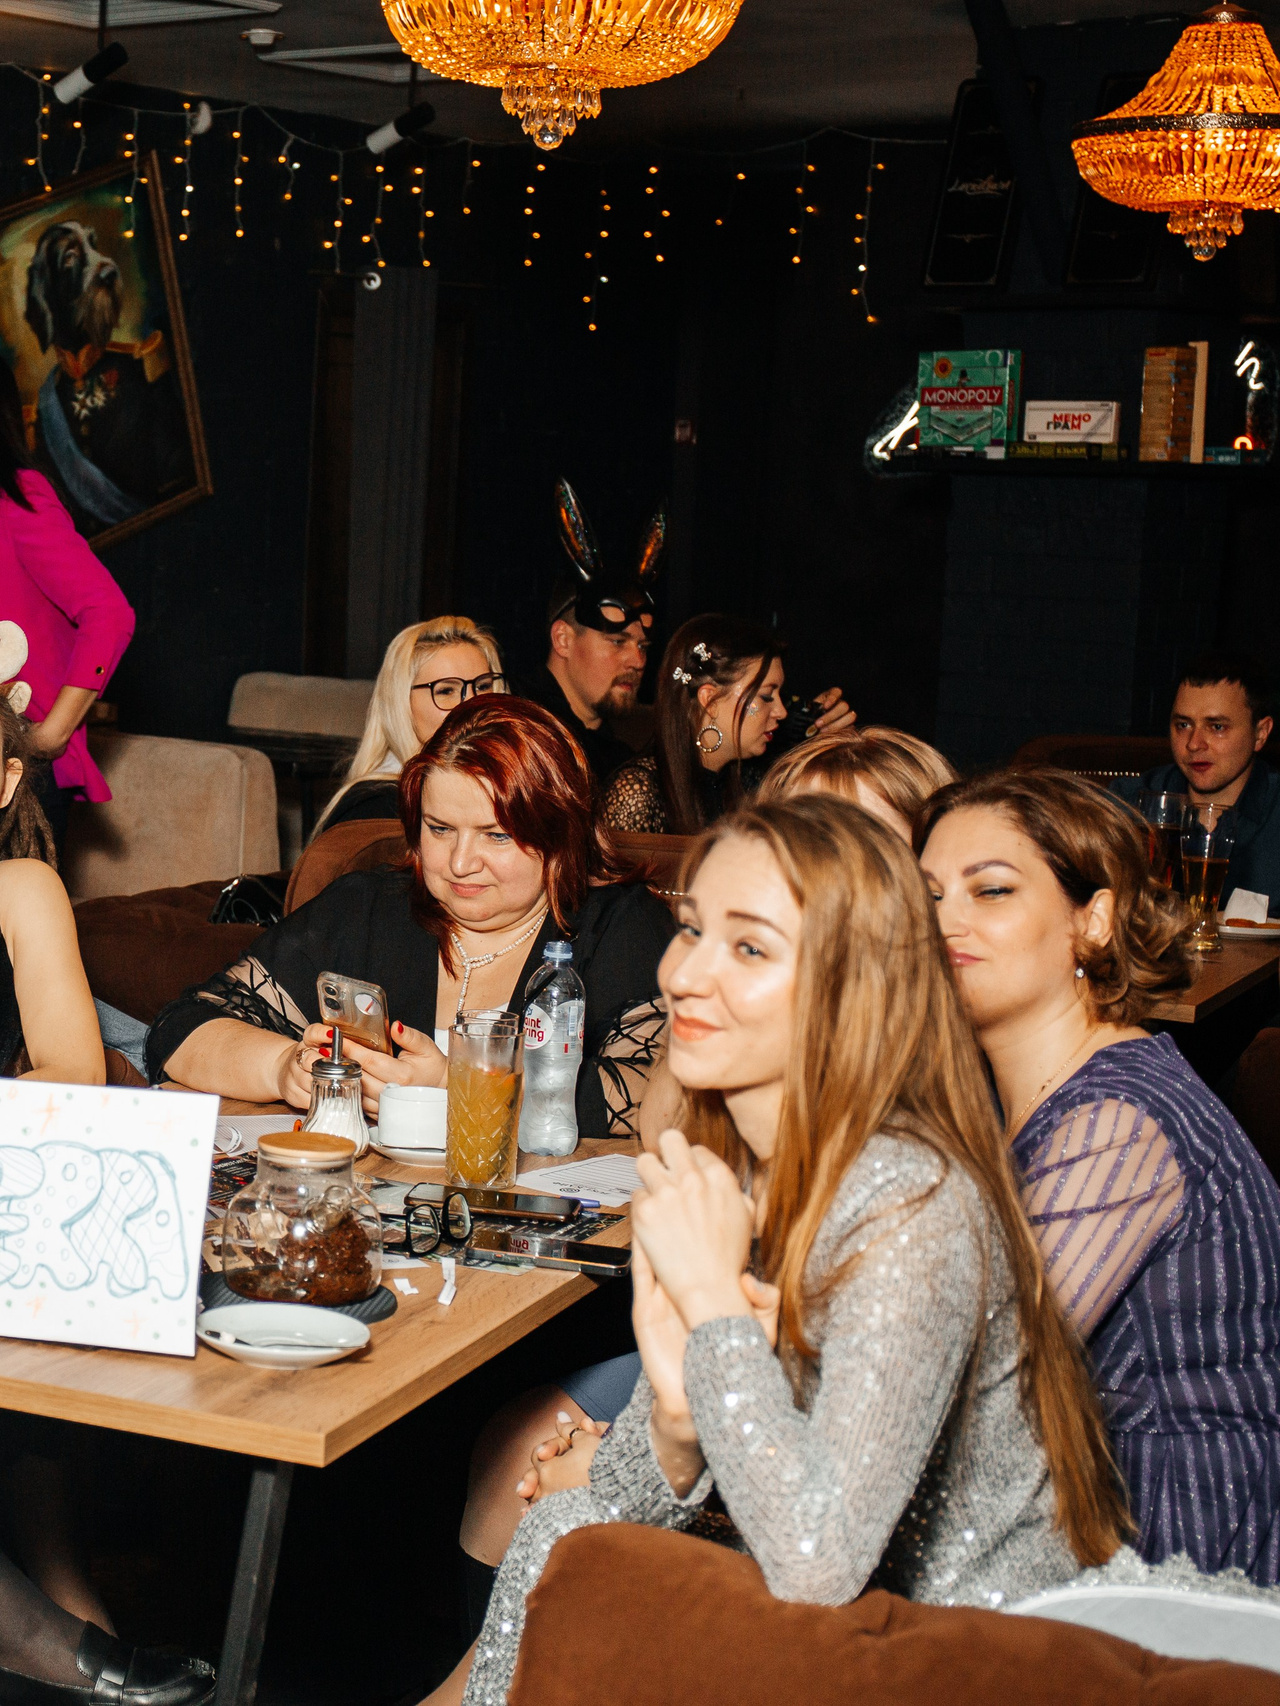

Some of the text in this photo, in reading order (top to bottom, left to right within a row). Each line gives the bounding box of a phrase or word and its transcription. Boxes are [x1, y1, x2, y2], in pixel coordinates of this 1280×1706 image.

[924, 389, 1001, 403] MONOPOLY
[1047, 421, 1082, 430] ГРАМ
[524, 1016, 541, 1029] aint
